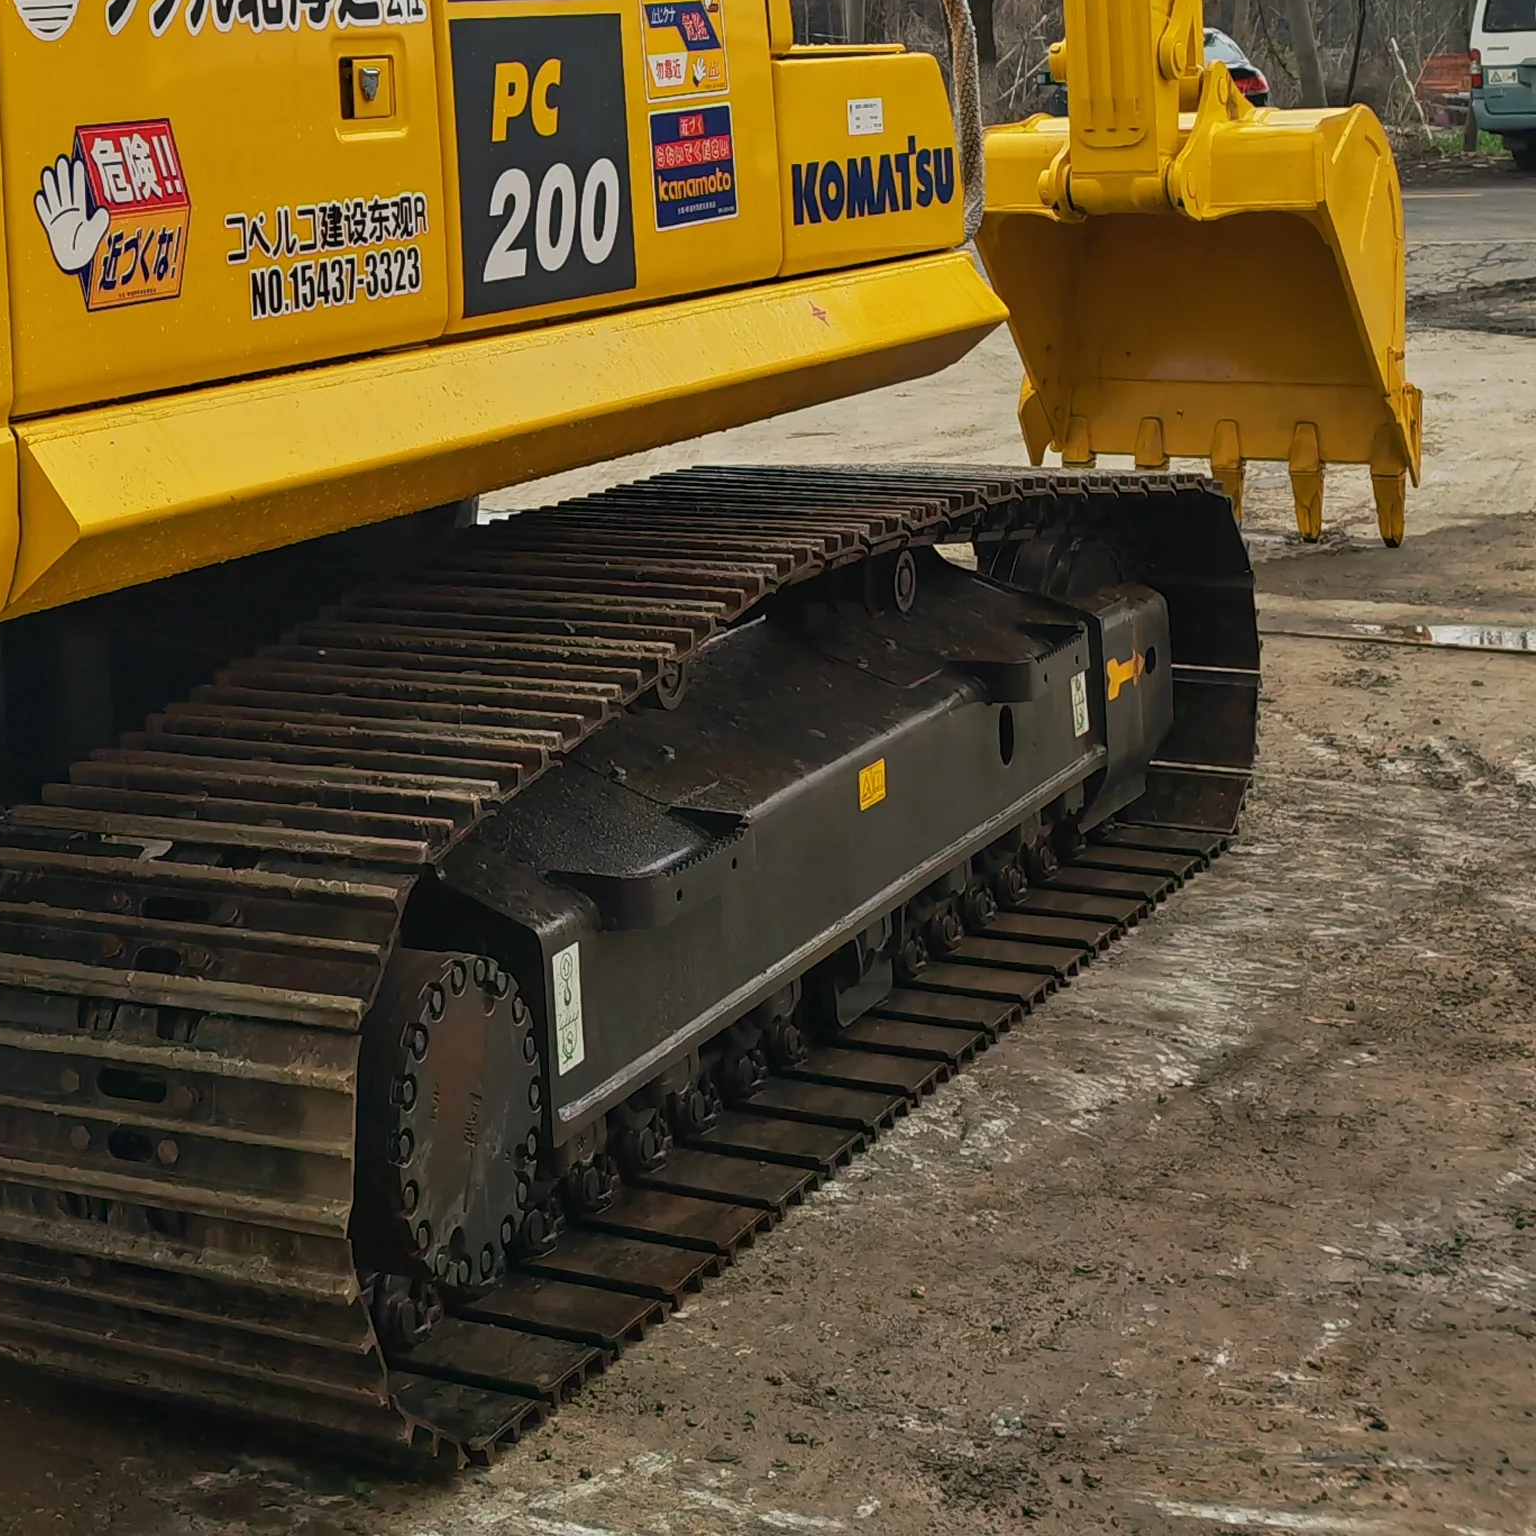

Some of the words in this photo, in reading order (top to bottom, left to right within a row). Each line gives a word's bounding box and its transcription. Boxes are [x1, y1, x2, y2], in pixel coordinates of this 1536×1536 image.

[490, 57, 562, 143] PC
[482, 157, 620, 283] 200
[657, 166, 732, 202] kanamoto
[791, 135, 955, 226] KOMATSU
[250, 246, 421, 318] NO.15437-3323
